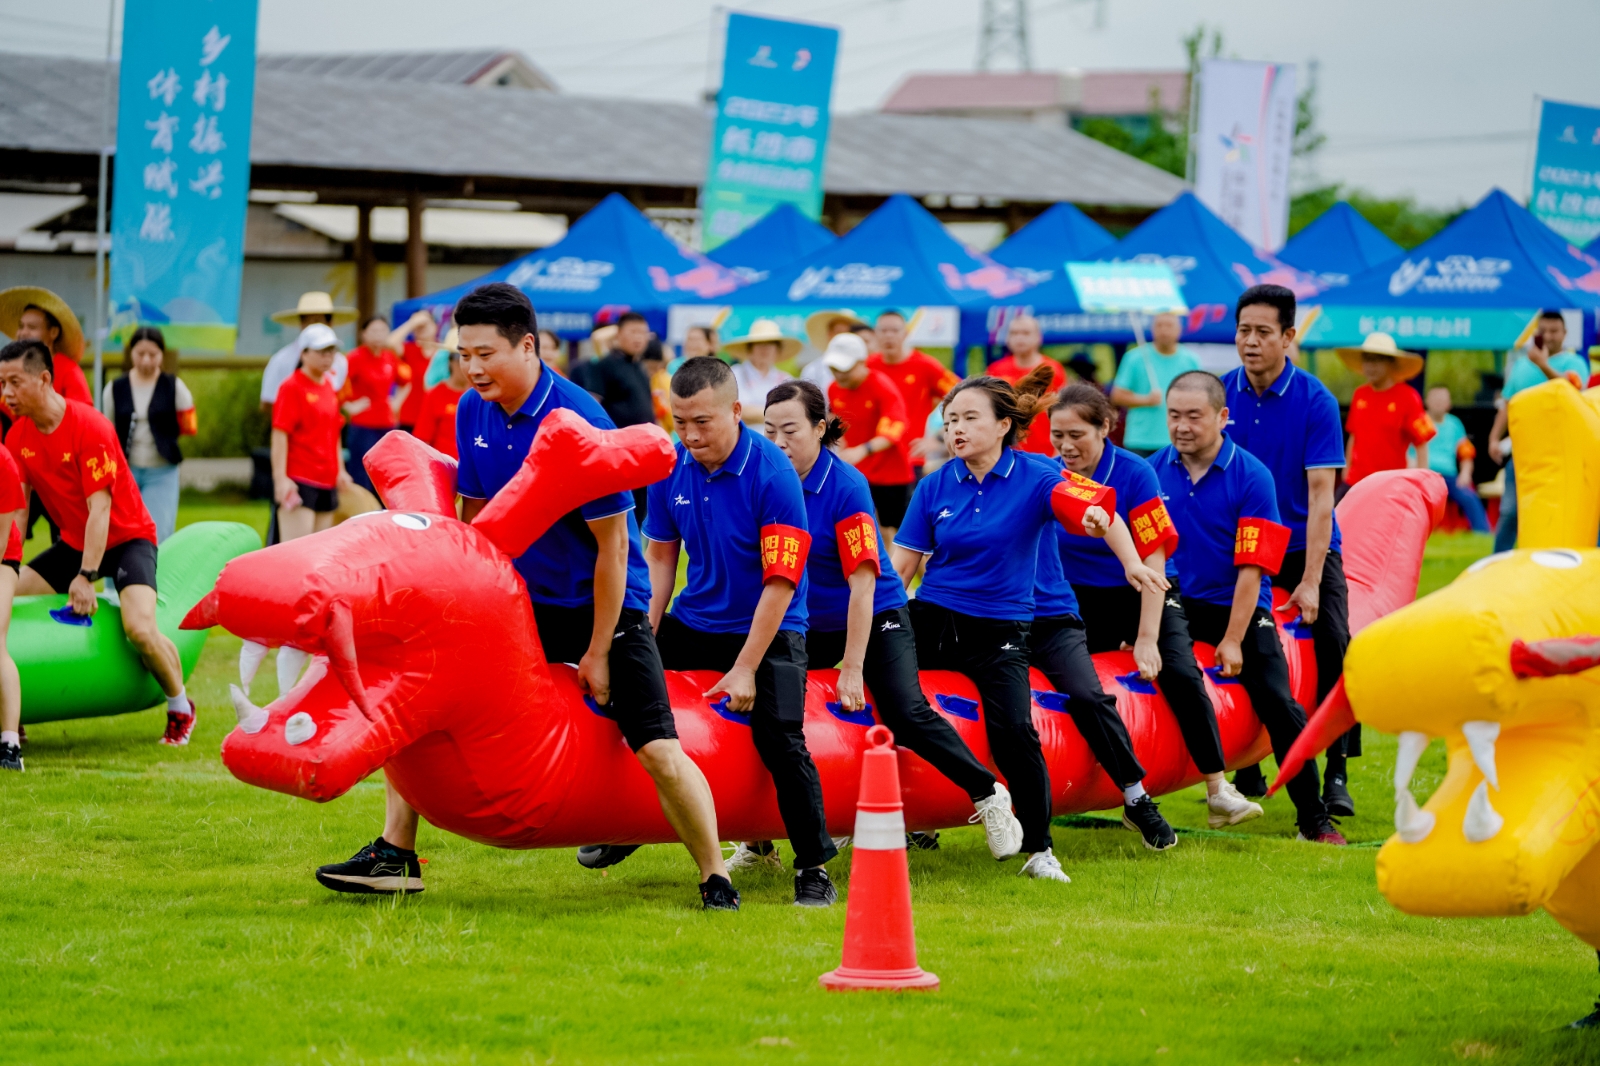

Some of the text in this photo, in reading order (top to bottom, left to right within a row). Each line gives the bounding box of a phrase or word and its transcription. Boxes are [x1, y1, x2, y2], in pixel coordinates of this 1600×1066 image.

[139, 67, 183, 242] 体育赋能
[189, 24, 231, 200] 乡村振兴
[760, 534, 800, 553] 阳市
